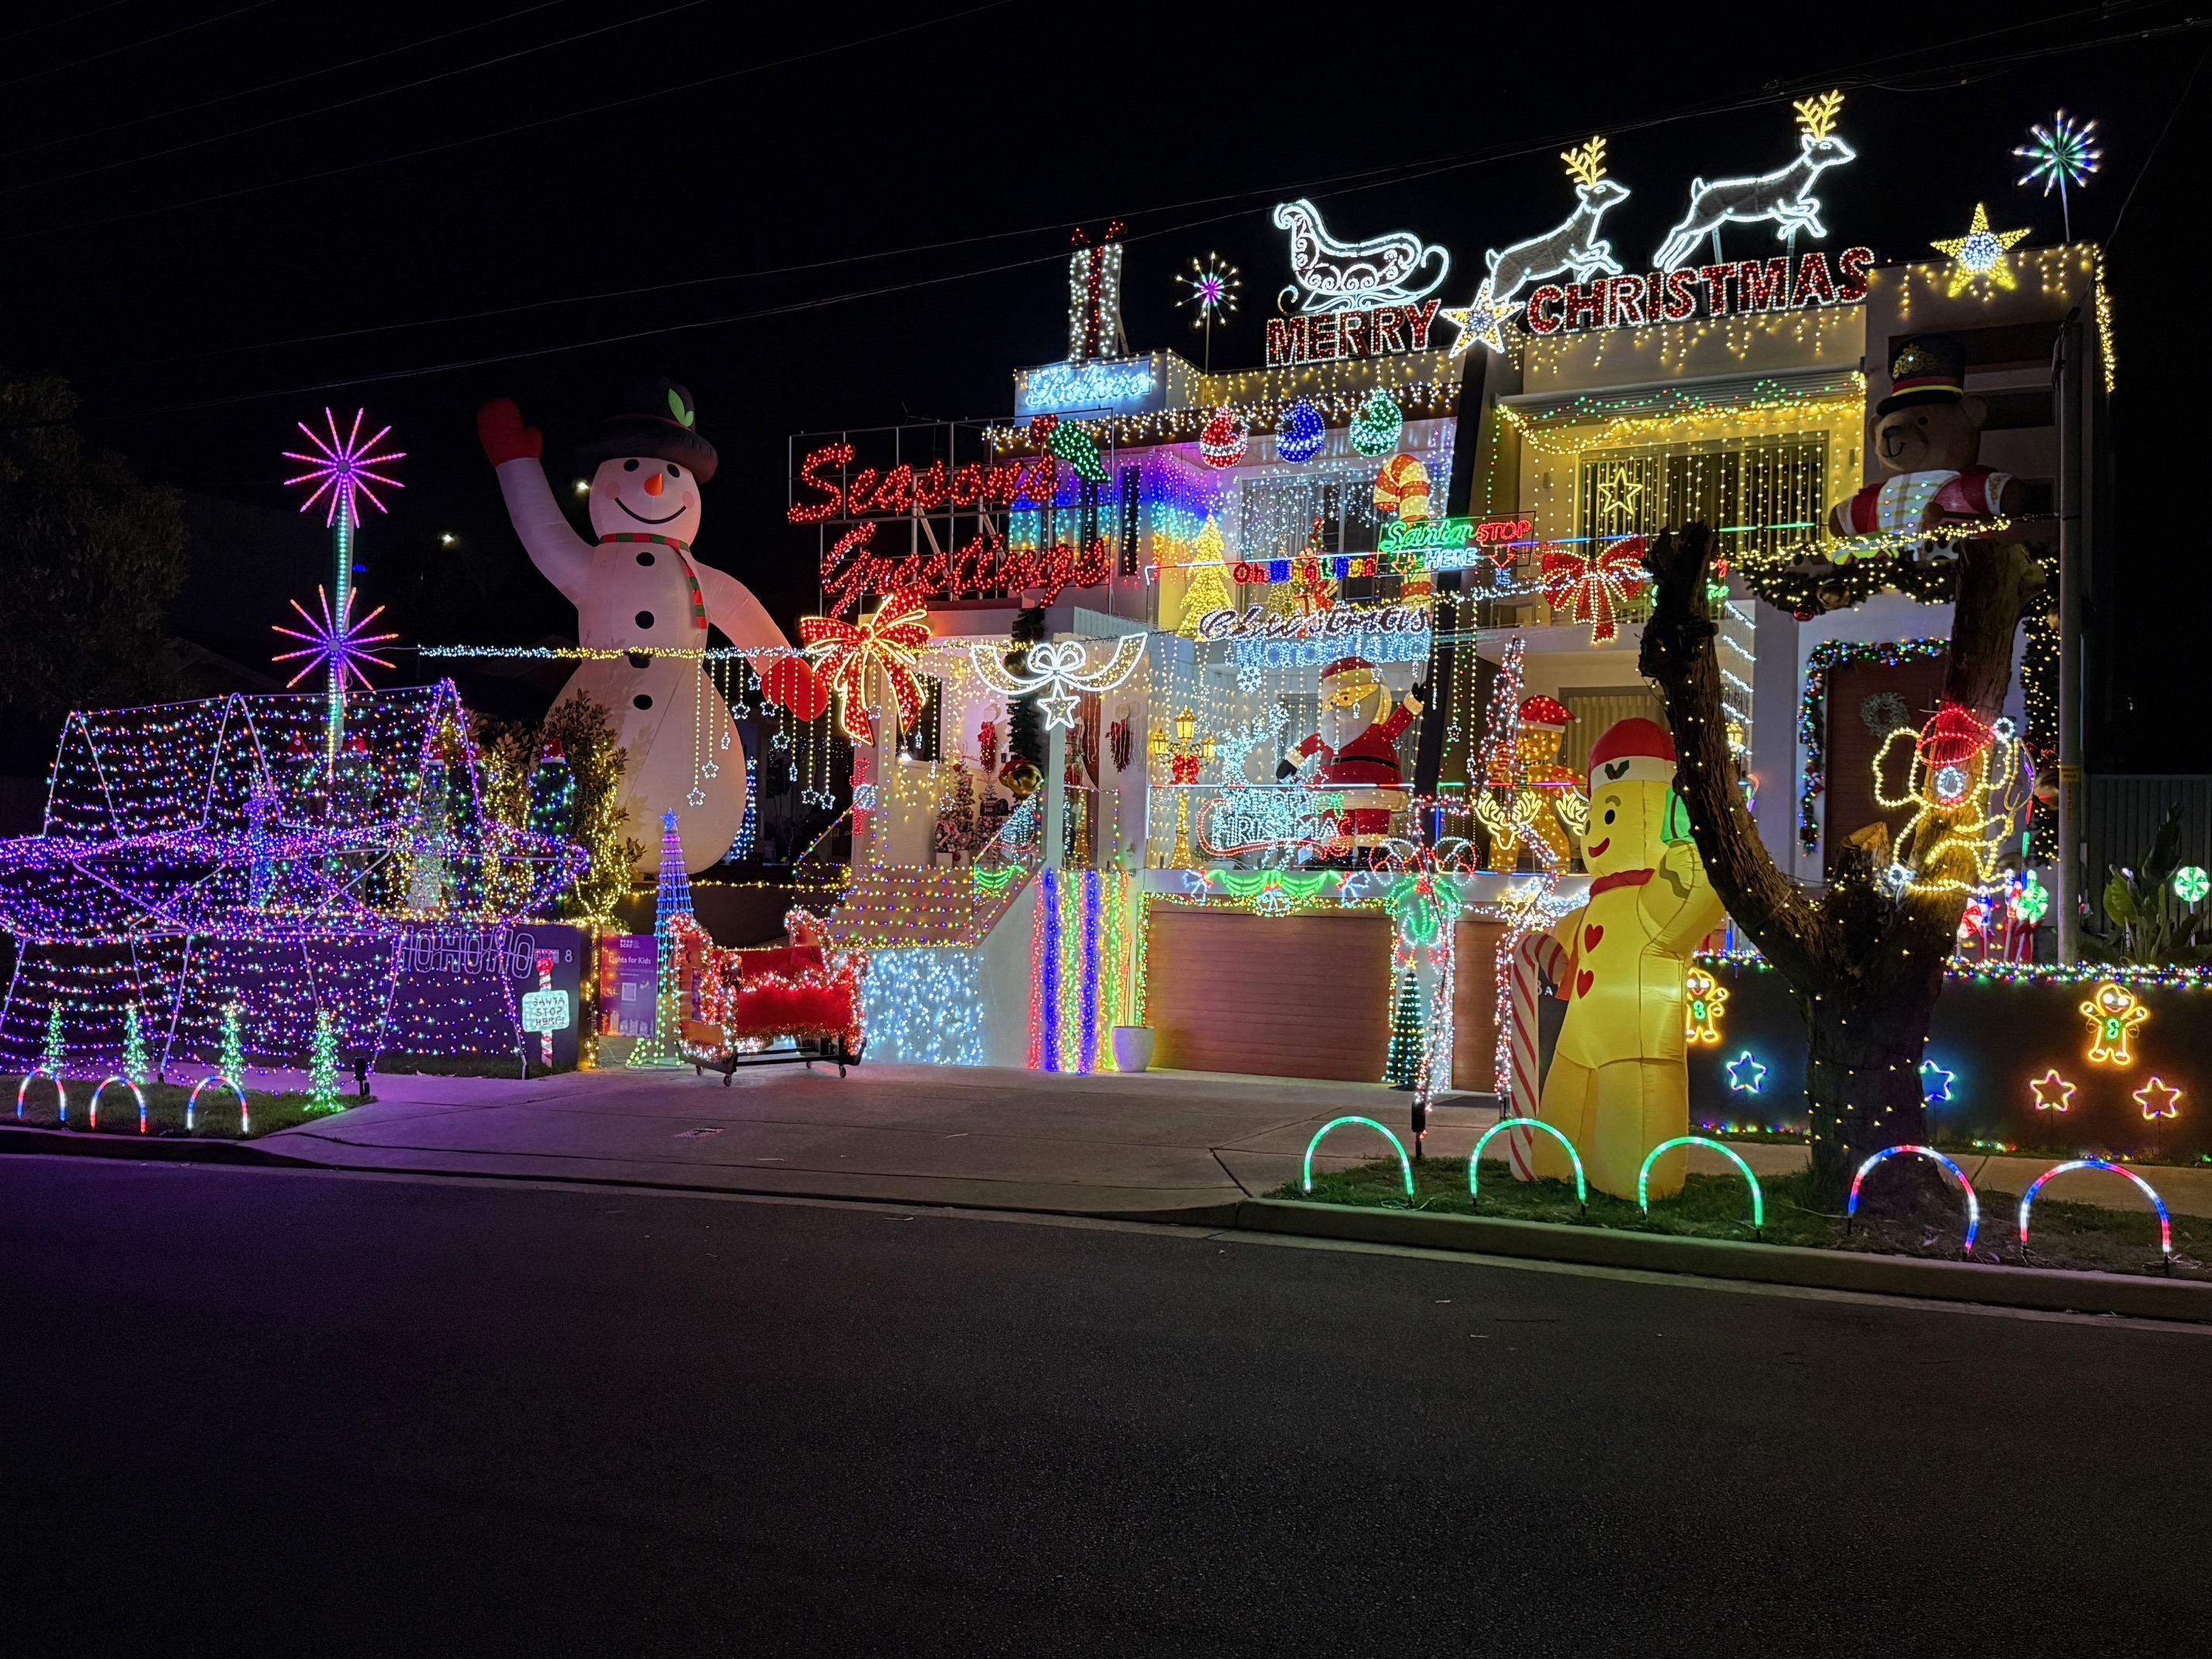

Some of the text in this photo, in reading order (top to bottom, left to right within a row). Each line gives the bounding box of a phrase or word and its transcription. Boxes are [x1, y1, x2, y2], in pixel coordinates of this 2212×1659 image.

[1266, 246, 1876, 367] MERRY CHRISTMAS
[1475, 519, 1532, 541] STOP
[1424, 547, 1478, 568] HERE
[819, 520, 1112, 618] Greetings
[1233, 562, 1268, 586] Oh
[565, 949, 573, 963] 8
[532, 997, 565, 1006] SANTA
[536, 1008, 562, 1016] STOP
